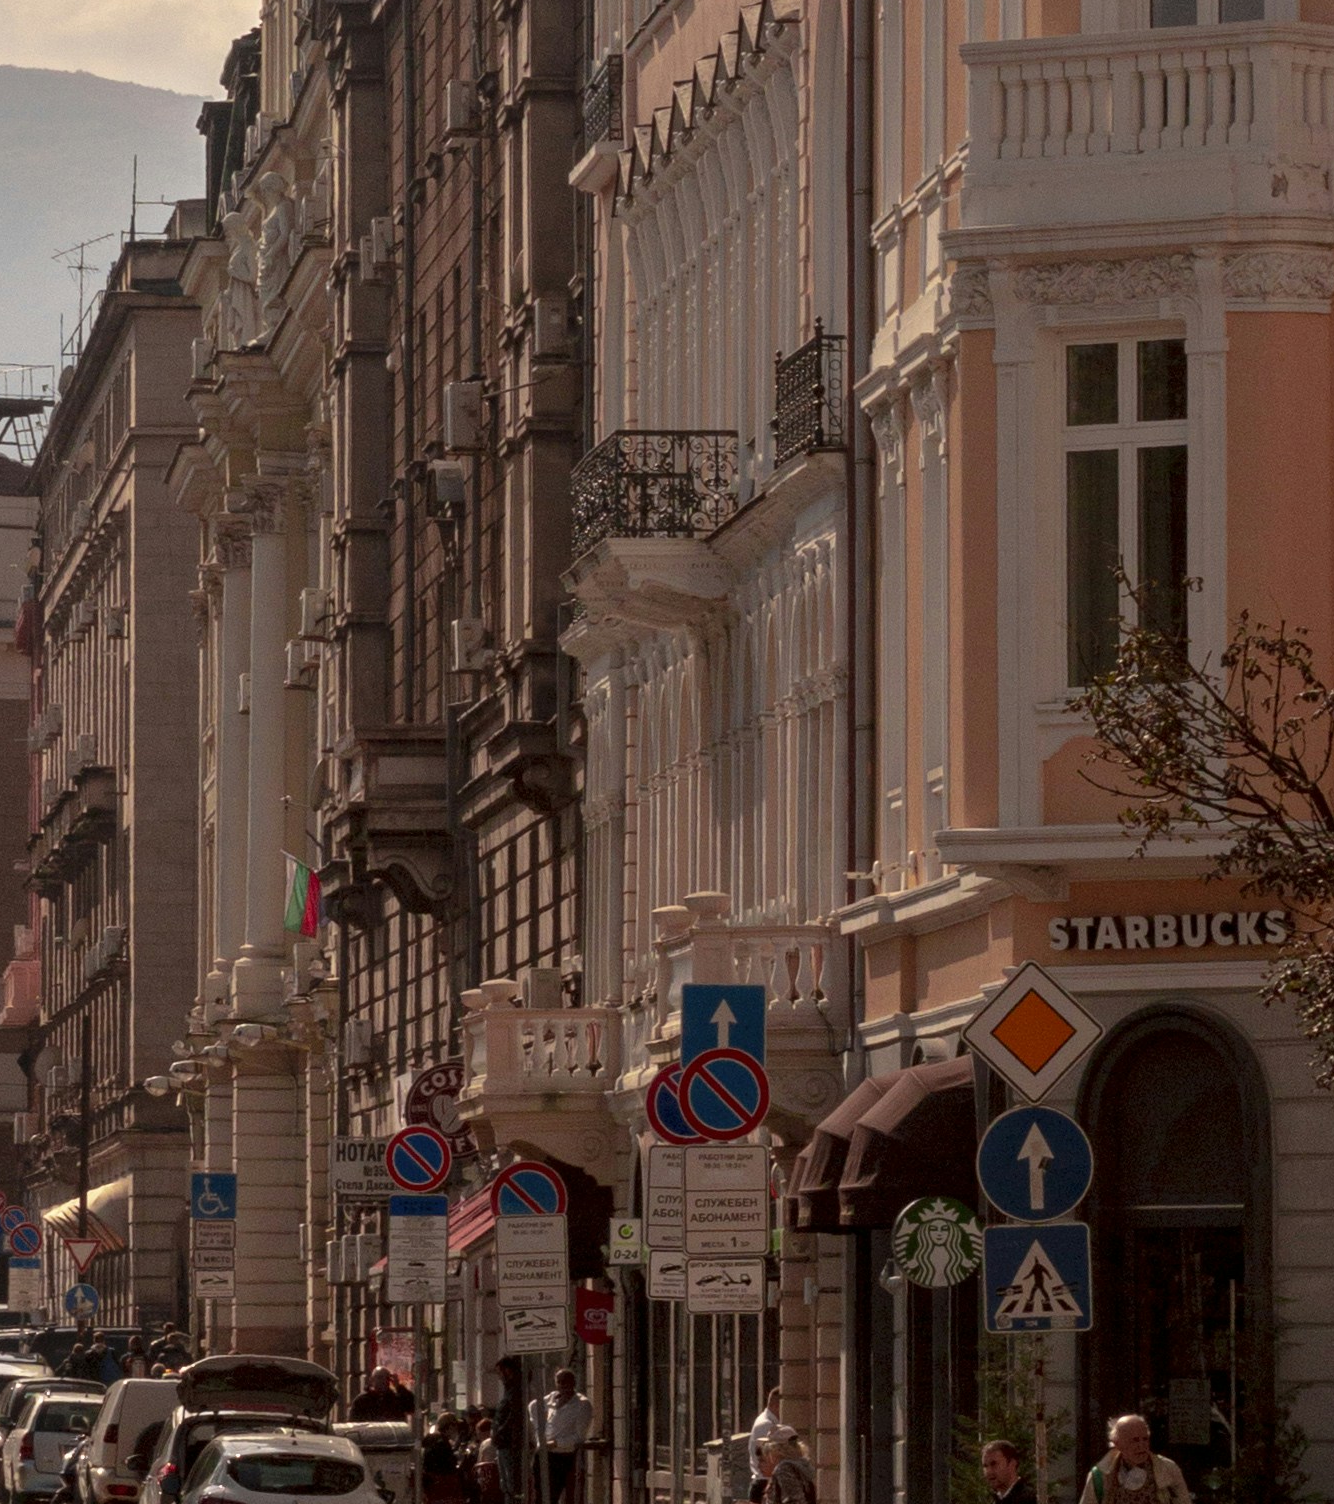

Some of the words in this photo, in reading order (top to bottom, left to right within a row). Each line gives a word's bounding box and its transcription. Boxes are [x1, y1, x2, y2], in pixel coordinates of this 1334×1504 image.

[1048, 909, 1288, 952] STARBUCKS
[695, 1197, 758, 1208] СЛУЖЕБЕН
[690, 1212, 762, 1223] АБОНАМЕНТ
[731, 1236, 737, 1247] 1
[613, 1249, 638, 1260] 0-24
[506, 1259, 559, 1269] СЛУЖЕБЕН
[502, 1270, 563, 1281] АБОНАМЕНТ
